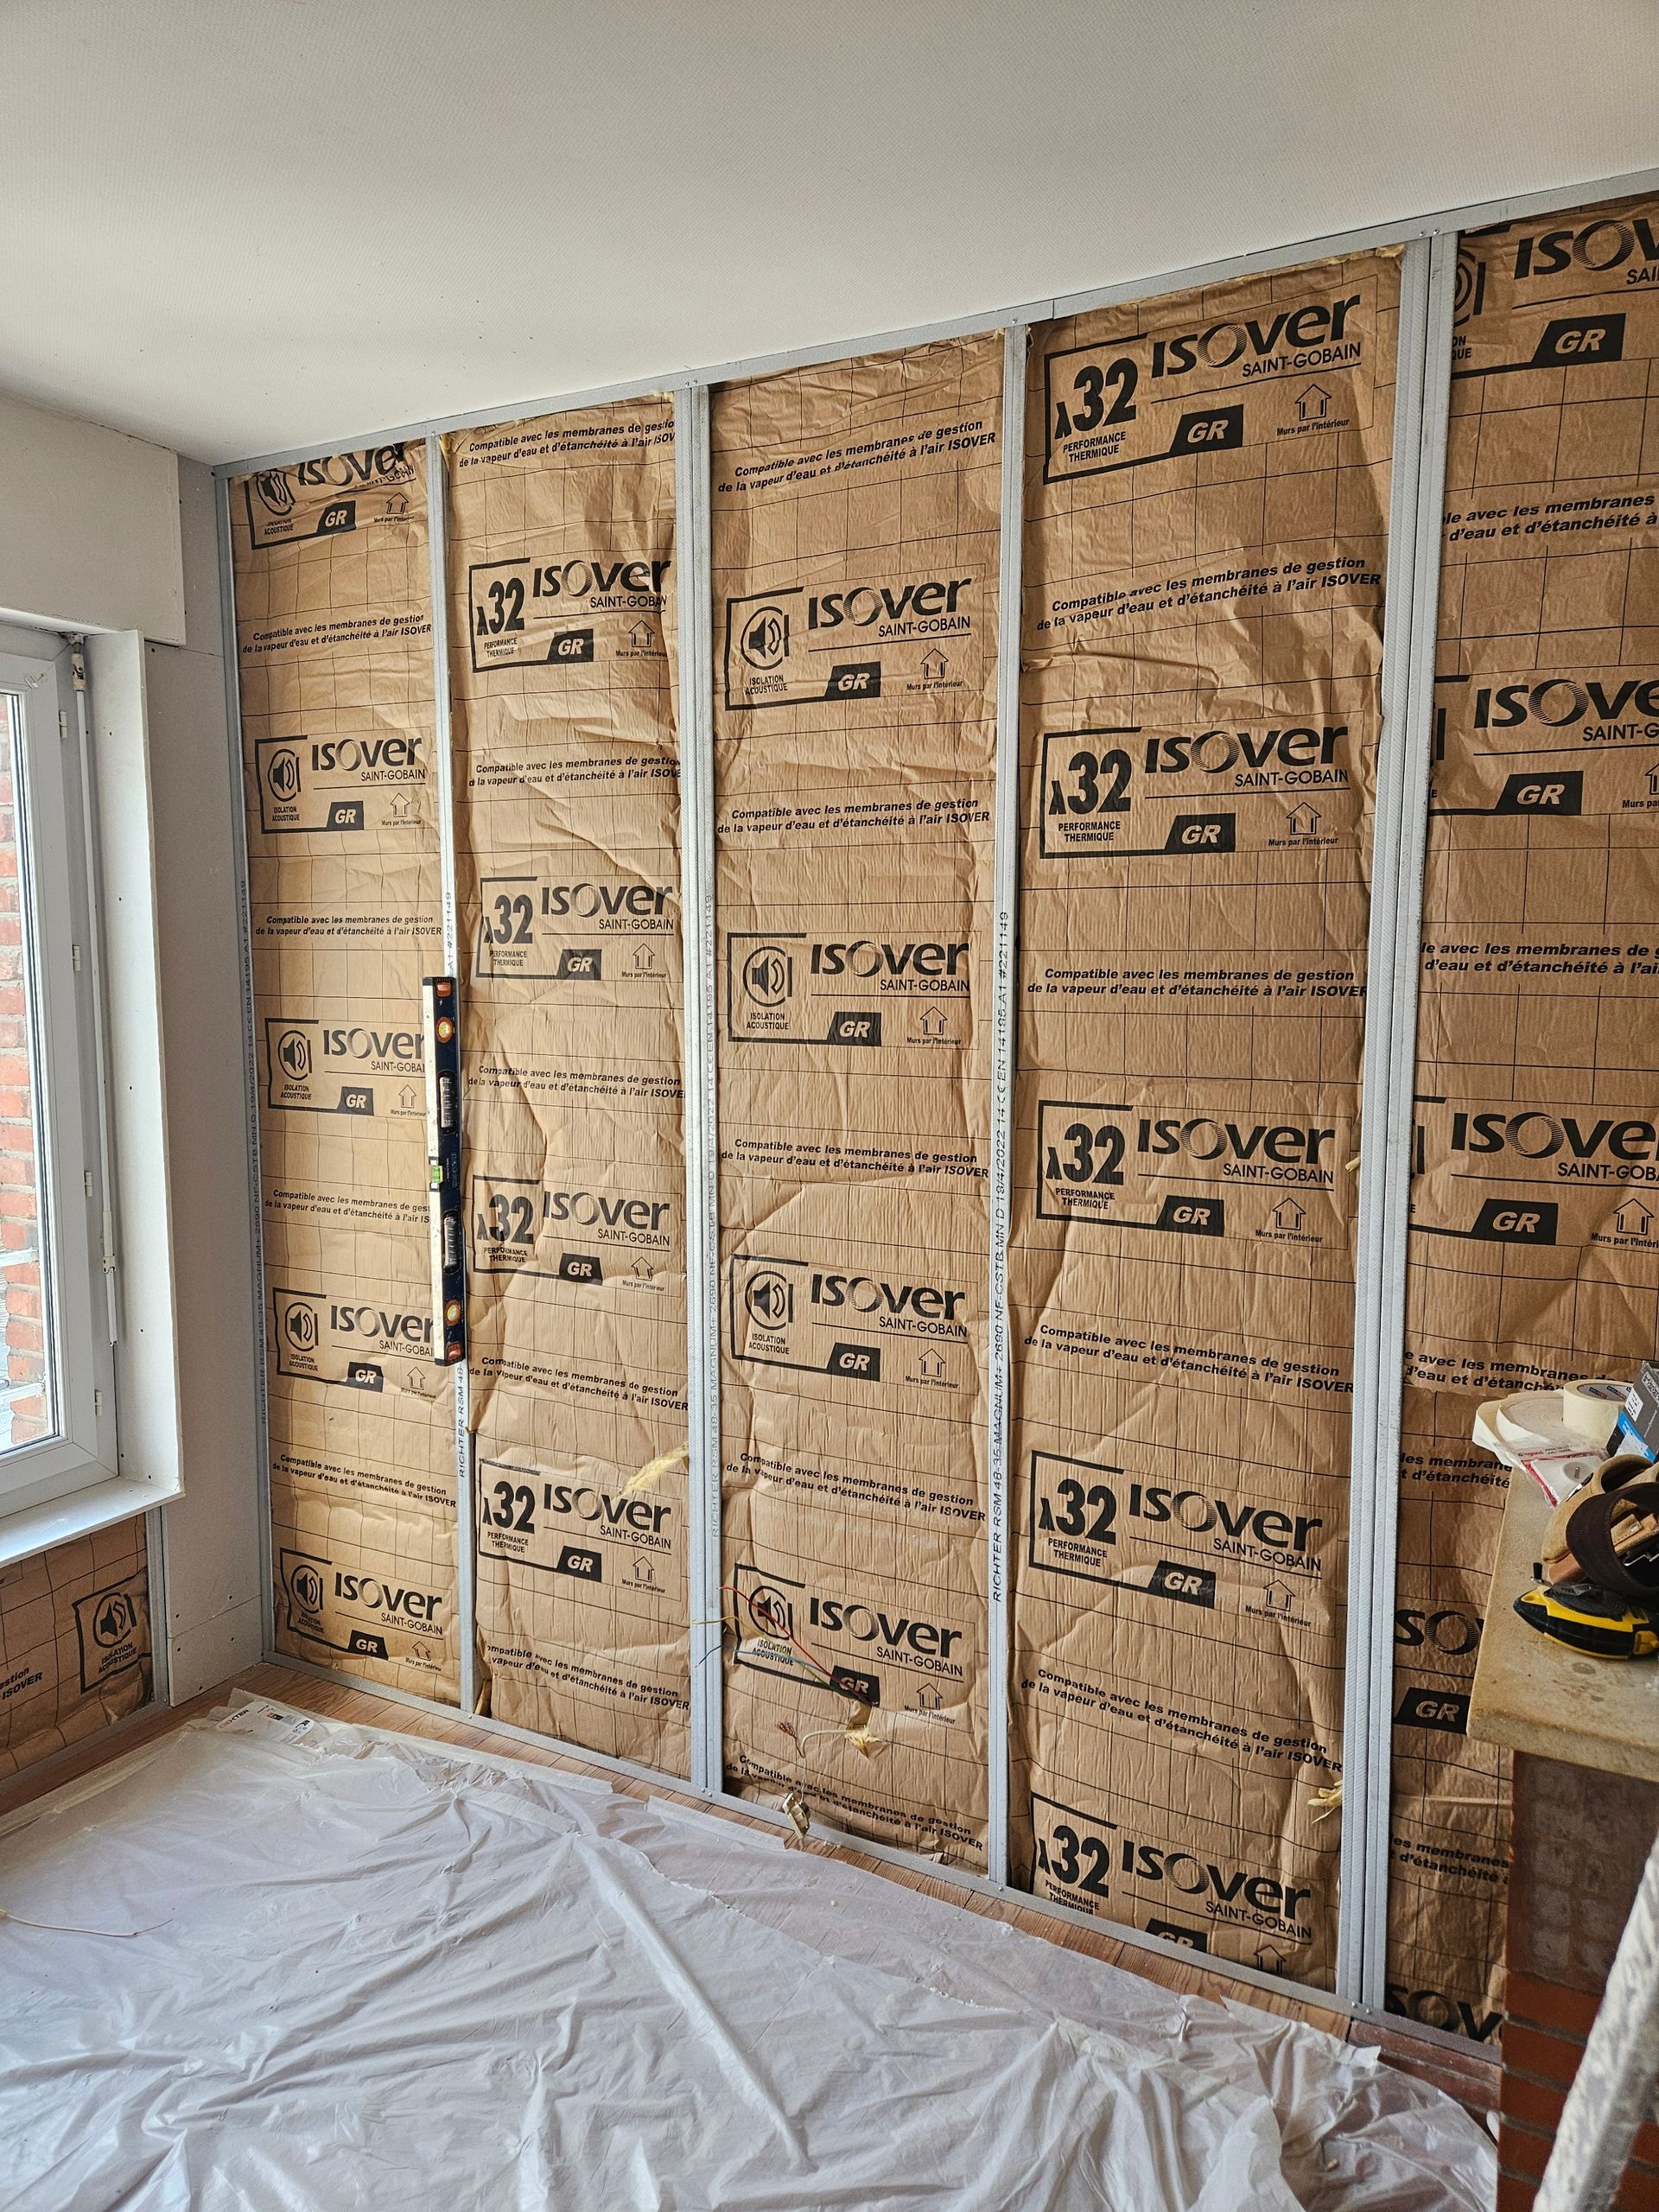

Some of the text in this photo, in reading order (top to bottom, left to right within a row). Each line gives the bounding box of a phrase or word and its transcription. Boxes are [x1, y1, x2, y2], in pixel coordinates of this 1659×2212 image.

[1555, 328, 1605, 353] GR
[1243, 341, 1362, 378] SAINT-GOBAIN
[1187, 419, 1228, 443] GR
[1277, 417, 1350, 436] Murs par l'intérieur
[1063, 431, 1126, 454] PERFORMANCE
[1069, 444, 1119, 463] THERMIQUE
[1545, 493, 1655, 514] membranes
[325, 511, 347, 527] GR
[1524, 513, 1640, 536] d'étanchéité
[879, 616, 970, 638] SAINT-GOBAIN
[558, 638, 584, 656] GR
[837, 672, 870, 690] GR
[361, 769, 426, 781] SAINT-GOBAIN
[1235, 770, 1348, 787] SAINT-GOBAIN
[1516, 785, 1565, 805] GR
[334, 810, 355, 823] GR
[732, 798, 978, 819] Compatible avec les membranes de gestion
[717, 811, 989, 833] de la vapeur d'eau et d'étanchéité à l'air ISOVER
[1058, 820, 1121, 831] PERFORMANCE
[1065, 832, 1114, 842] THERMIQUE
[1181, 824, 1221, 844] GR
[267, 916, 308, 925] Compatible
[404, 916, 433, 925] gestion
[599, 918, 673, 930] SAINT-GOBAIN
[999, 912, 1008, 979] #221149
[1440, 942, 1649, 957] avec les membranes de
[567, 957, 593, 972] GR
[1046, 968, 1354, 982] Compatible avec les membranes de gestion
[880, 980, 969, 992] SAINT-GOBAIN
[999, 986, 1007, 1003] A1
[1027, 982, 1042, 993] de
[1046, 982, 1058, 993] la
[1062, 984, 1107, 995] vapeur
[1110, 983, 1147, 994] d'eau
[1151, 984, 1165, 995] et
[1169, 984, 1258, 996] d'étanchéité
[1263, 984, 1272, 995] à
[1277, 985, 1307, 996] l'air
[747, 1021, 789, 1030] ACOUSTIQUE
[839, 1020, 870, 1037] GR
[480, 1065, 527, 1077] Compatible
[554, 1071, 567, 1079] les
[570, 1071, 624, 1083] membranes
[642, 1076, 680, 1086] gestion
[997, 1059, 1007, 1081] EN
[346, 1094, 365, 1108] GR
[997, 1109, 1005, 1123] 14
[1224, 1163, 1333, 1185] SAINT-GOBAIN
[1056, 1187, 1116, 1201] PERFORMANCE
[1062, 1197, 1109, 1210] THERMIQUE
[1173, 1205, 1210, 1226] GR
[1493, 1211, 1541, 1233] GR
[598, 1229, 670, 1246] SAINT-GOBAIN
[995, 1224, 1005, 1248] MN
[567, 1262, 592, 1276] GR
[880, 1316, 967, 1337] SAINT-GOBAIN
[752, 1332, 785, 1344] ISOLATION
[995, 1325, 1003, 1360] 2690
[749, 1342, 789, 1354] ACOUSTIQUE
[839, 1352, 869, 1371] GR
[355, 1370, 376, 1383] GR
[993, 1493, 1002, 1526] RSM
[487, 1531, 529, 1546] PERFORMANCE
[600, 1525, 671, 1549] SAINT-GOBAIN
[492, 1541, 524, 1553] THERMIQUE
[1048, 1538, 1108, 1558] PERFORMANCE
[1213, 1537, 1321, 1572] SAINT-GOBAIN
[567, 1555, 594, 1573] GR
[993, 1533, 1001, 1601] RICHTER
[1053, 1549, 1101, 1567] THERMIQUE
[1164, 1572, 1203, 1595] GR
[381, 1613, 442, 1635] SAINT-GOBAIN
[356, 1639, 378, 1653] GR
[99, 1648, 137, 1674] ACOUSTIQUE
[877, 1646, 963, 1676] SAINT-GOBAIN
[2, 1672, 42, 1700] ISOVER
[1415, 1700, 1459, 1722] GR
[1046, 1879, 1099, 1910] PERFORMANCE
[1205, 1901, 1312, 1938] SAINT-GOBAIN
